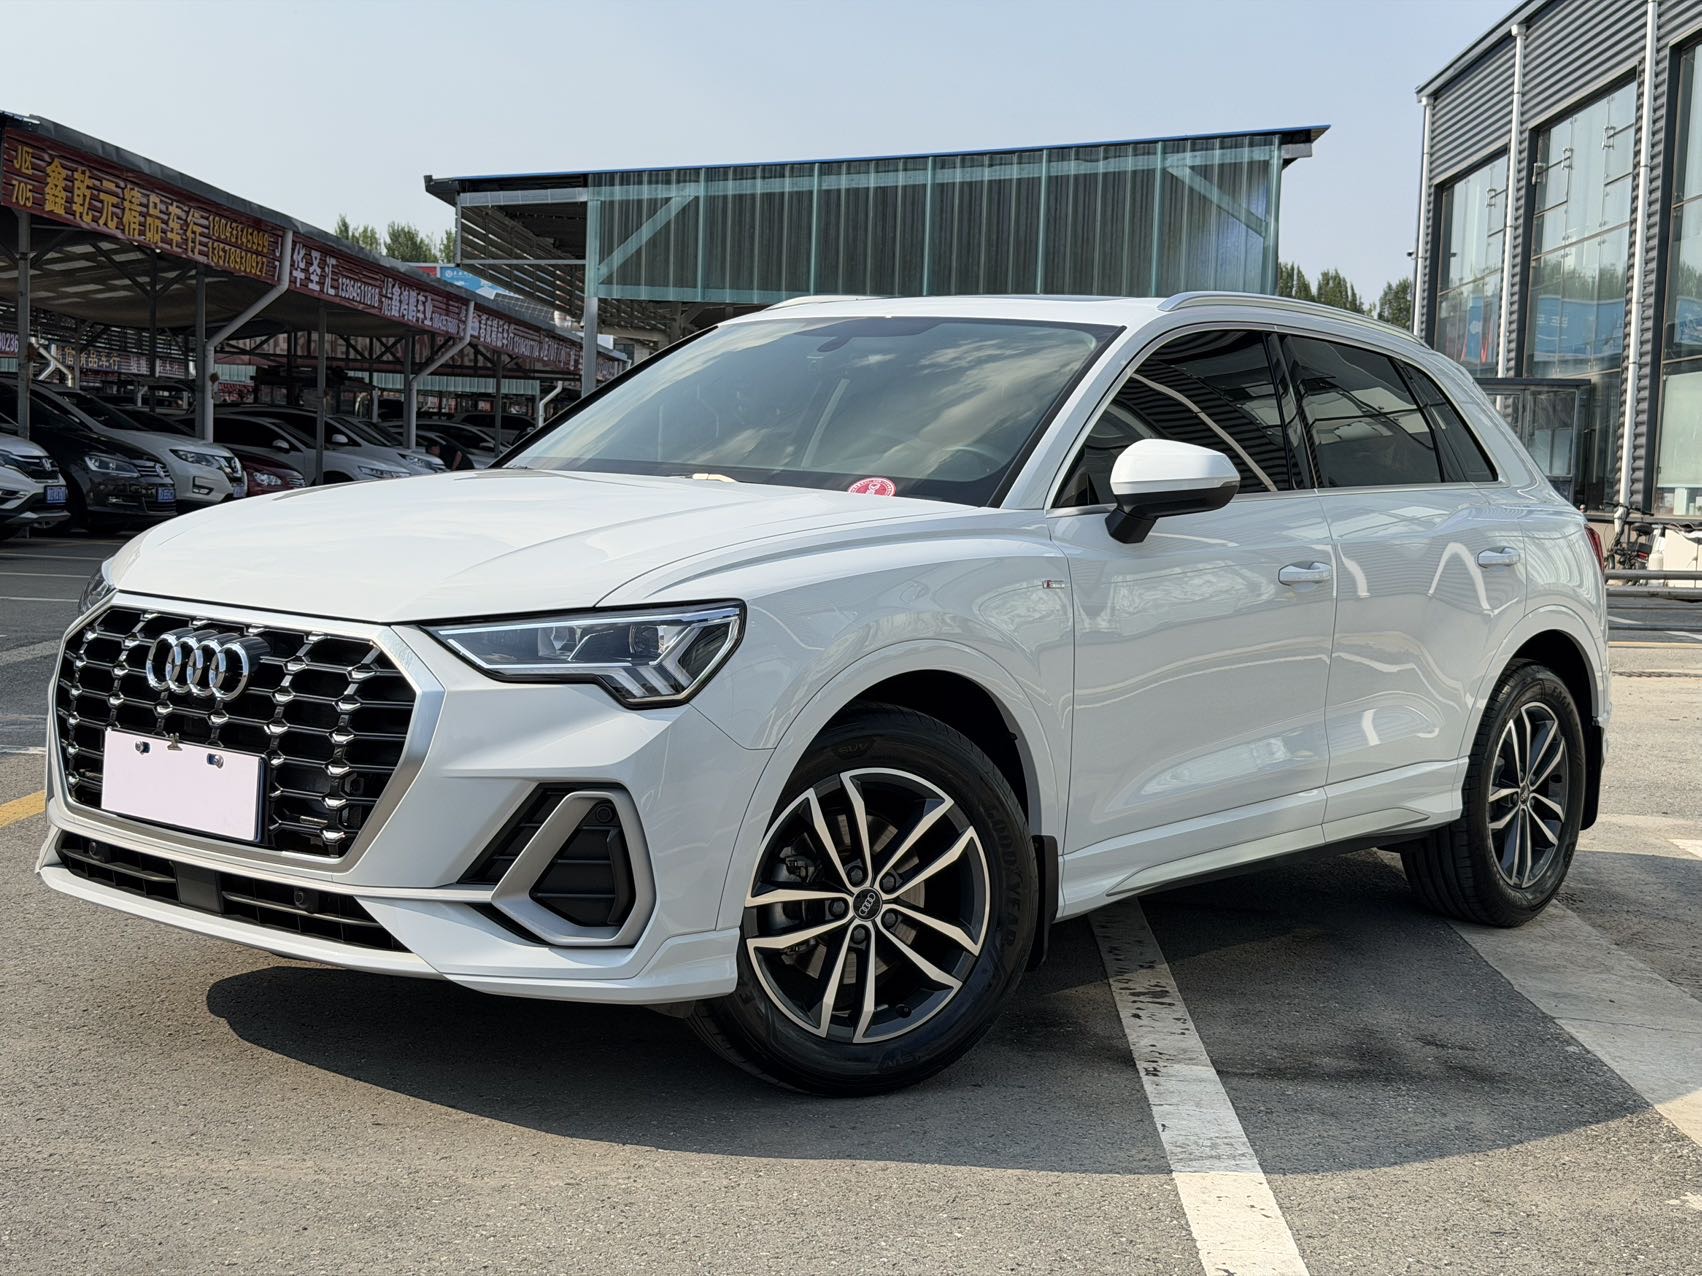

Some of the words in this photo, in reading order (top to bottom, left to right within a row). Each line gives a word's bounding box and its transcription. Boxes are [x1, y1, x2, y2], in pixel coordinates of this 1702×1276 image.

[13, 145, 33, 176] J区
[11, 180, 33, 207] 705
[207, 240, 268, 277] 13578930927
[292, 242, 336, 296] 华圣汇
[0, 333, 19, 352] 0236
